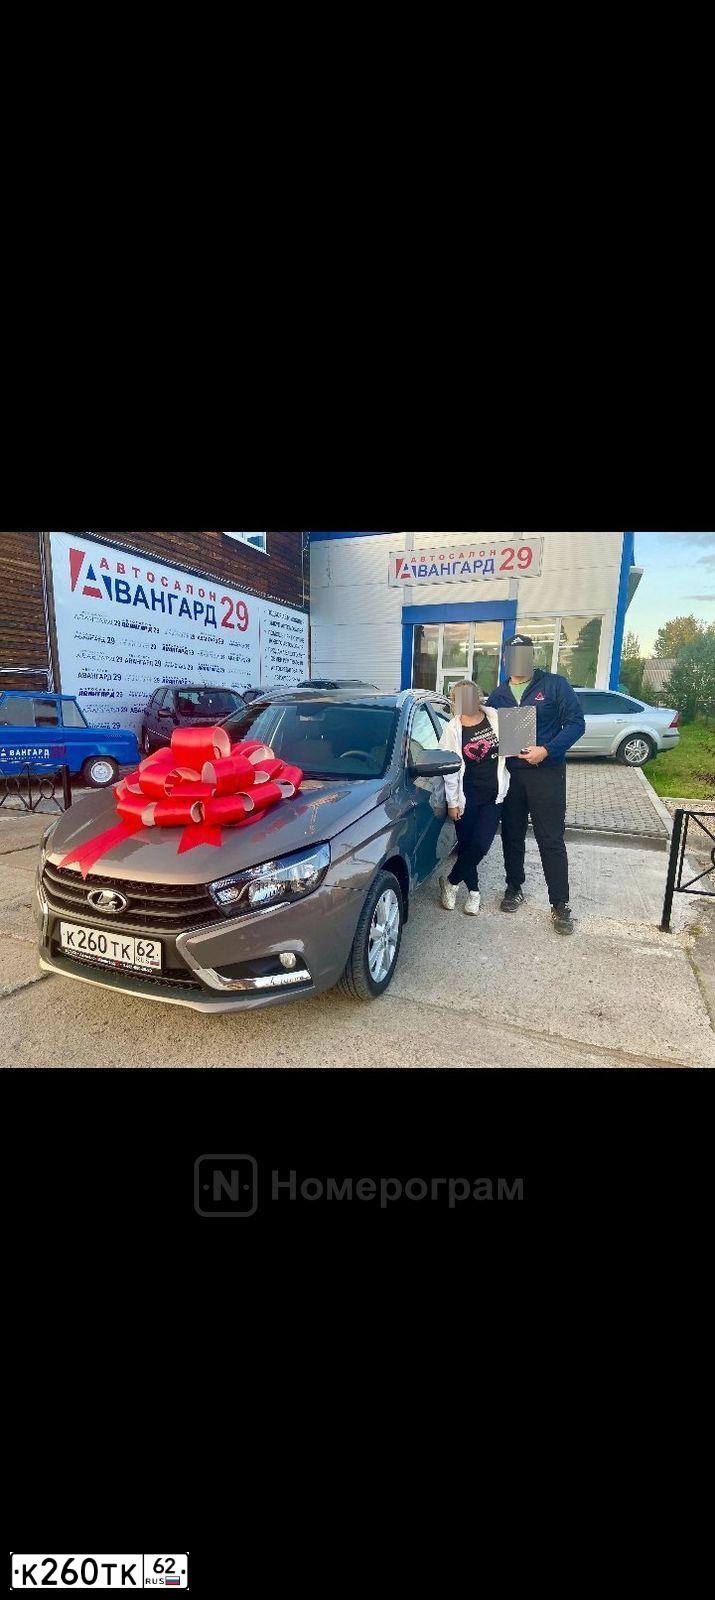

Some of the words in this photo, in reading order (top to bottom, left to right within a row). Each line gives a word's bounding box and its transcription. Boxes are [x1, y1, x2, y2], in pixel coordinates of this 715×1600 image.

[395, 557, 495, 580] АВАНГАРД
[499, 546, 533, 572] 29
[410, 549, 497, 563] АВТОСАЛОН
[68, 547, 217, 629] АВАНГАРД
[220, 595, 249, 632] 29
[99, 557, 217, 602] АВТОСАЛОН
[113, 673, 122, 682] 29
[66, 929, 131, 960] К260ТК
[136, 941, 155, 959] 62
